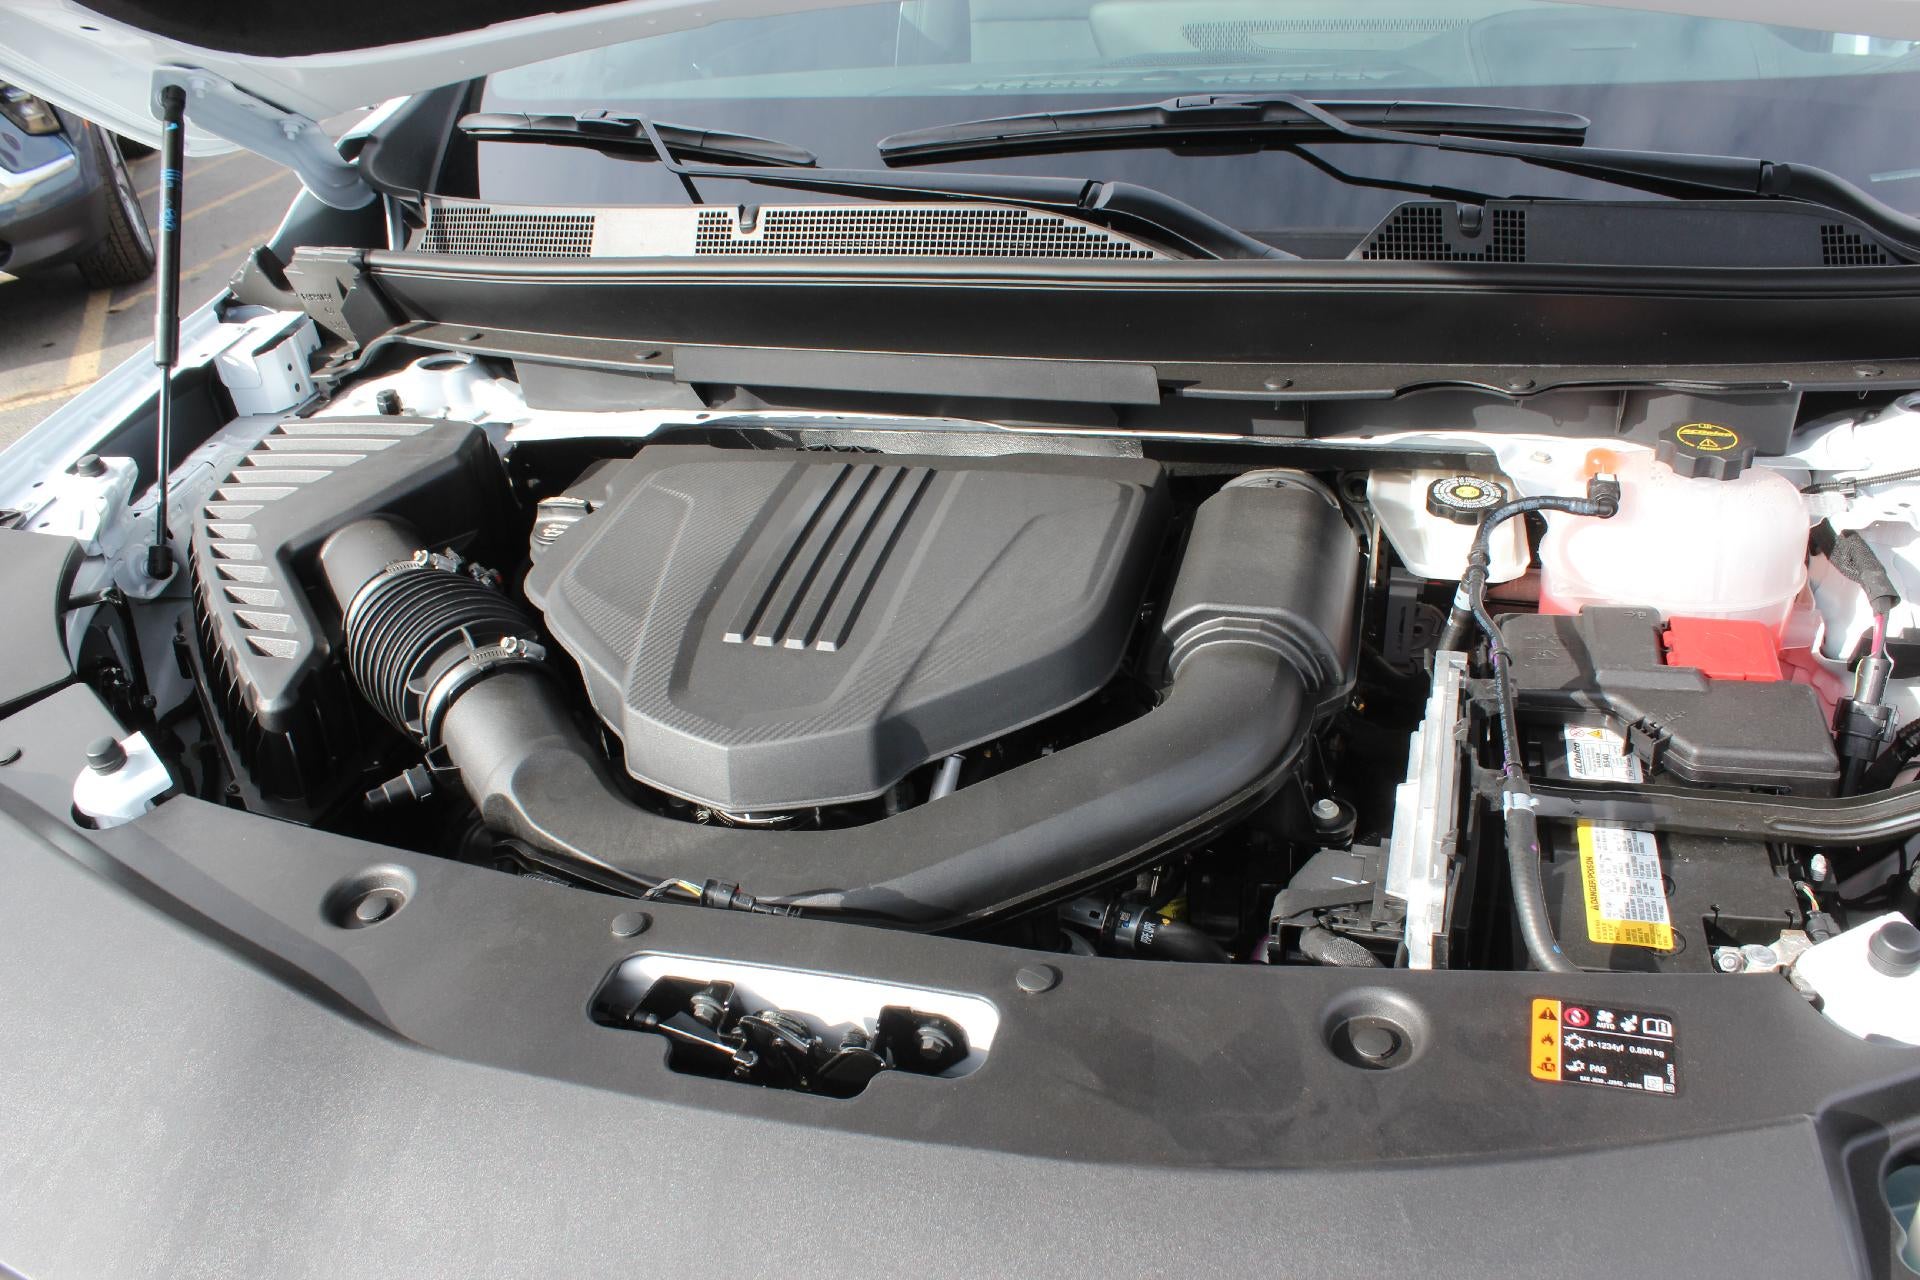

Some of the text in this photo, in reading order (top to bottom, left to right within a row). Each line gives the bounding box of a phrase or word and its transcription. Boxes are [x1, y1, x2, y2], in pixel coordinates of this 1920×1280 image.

[1573, 742, 1583, 774] ACDelco
[1596, 1021, 1616, 1030] AUTO
[1587, 1039, 1624, 1053] R-1234yf
[1654, 1048, 1665, 1058] kg
[1589, 1063, 1607, 1074] PAG
